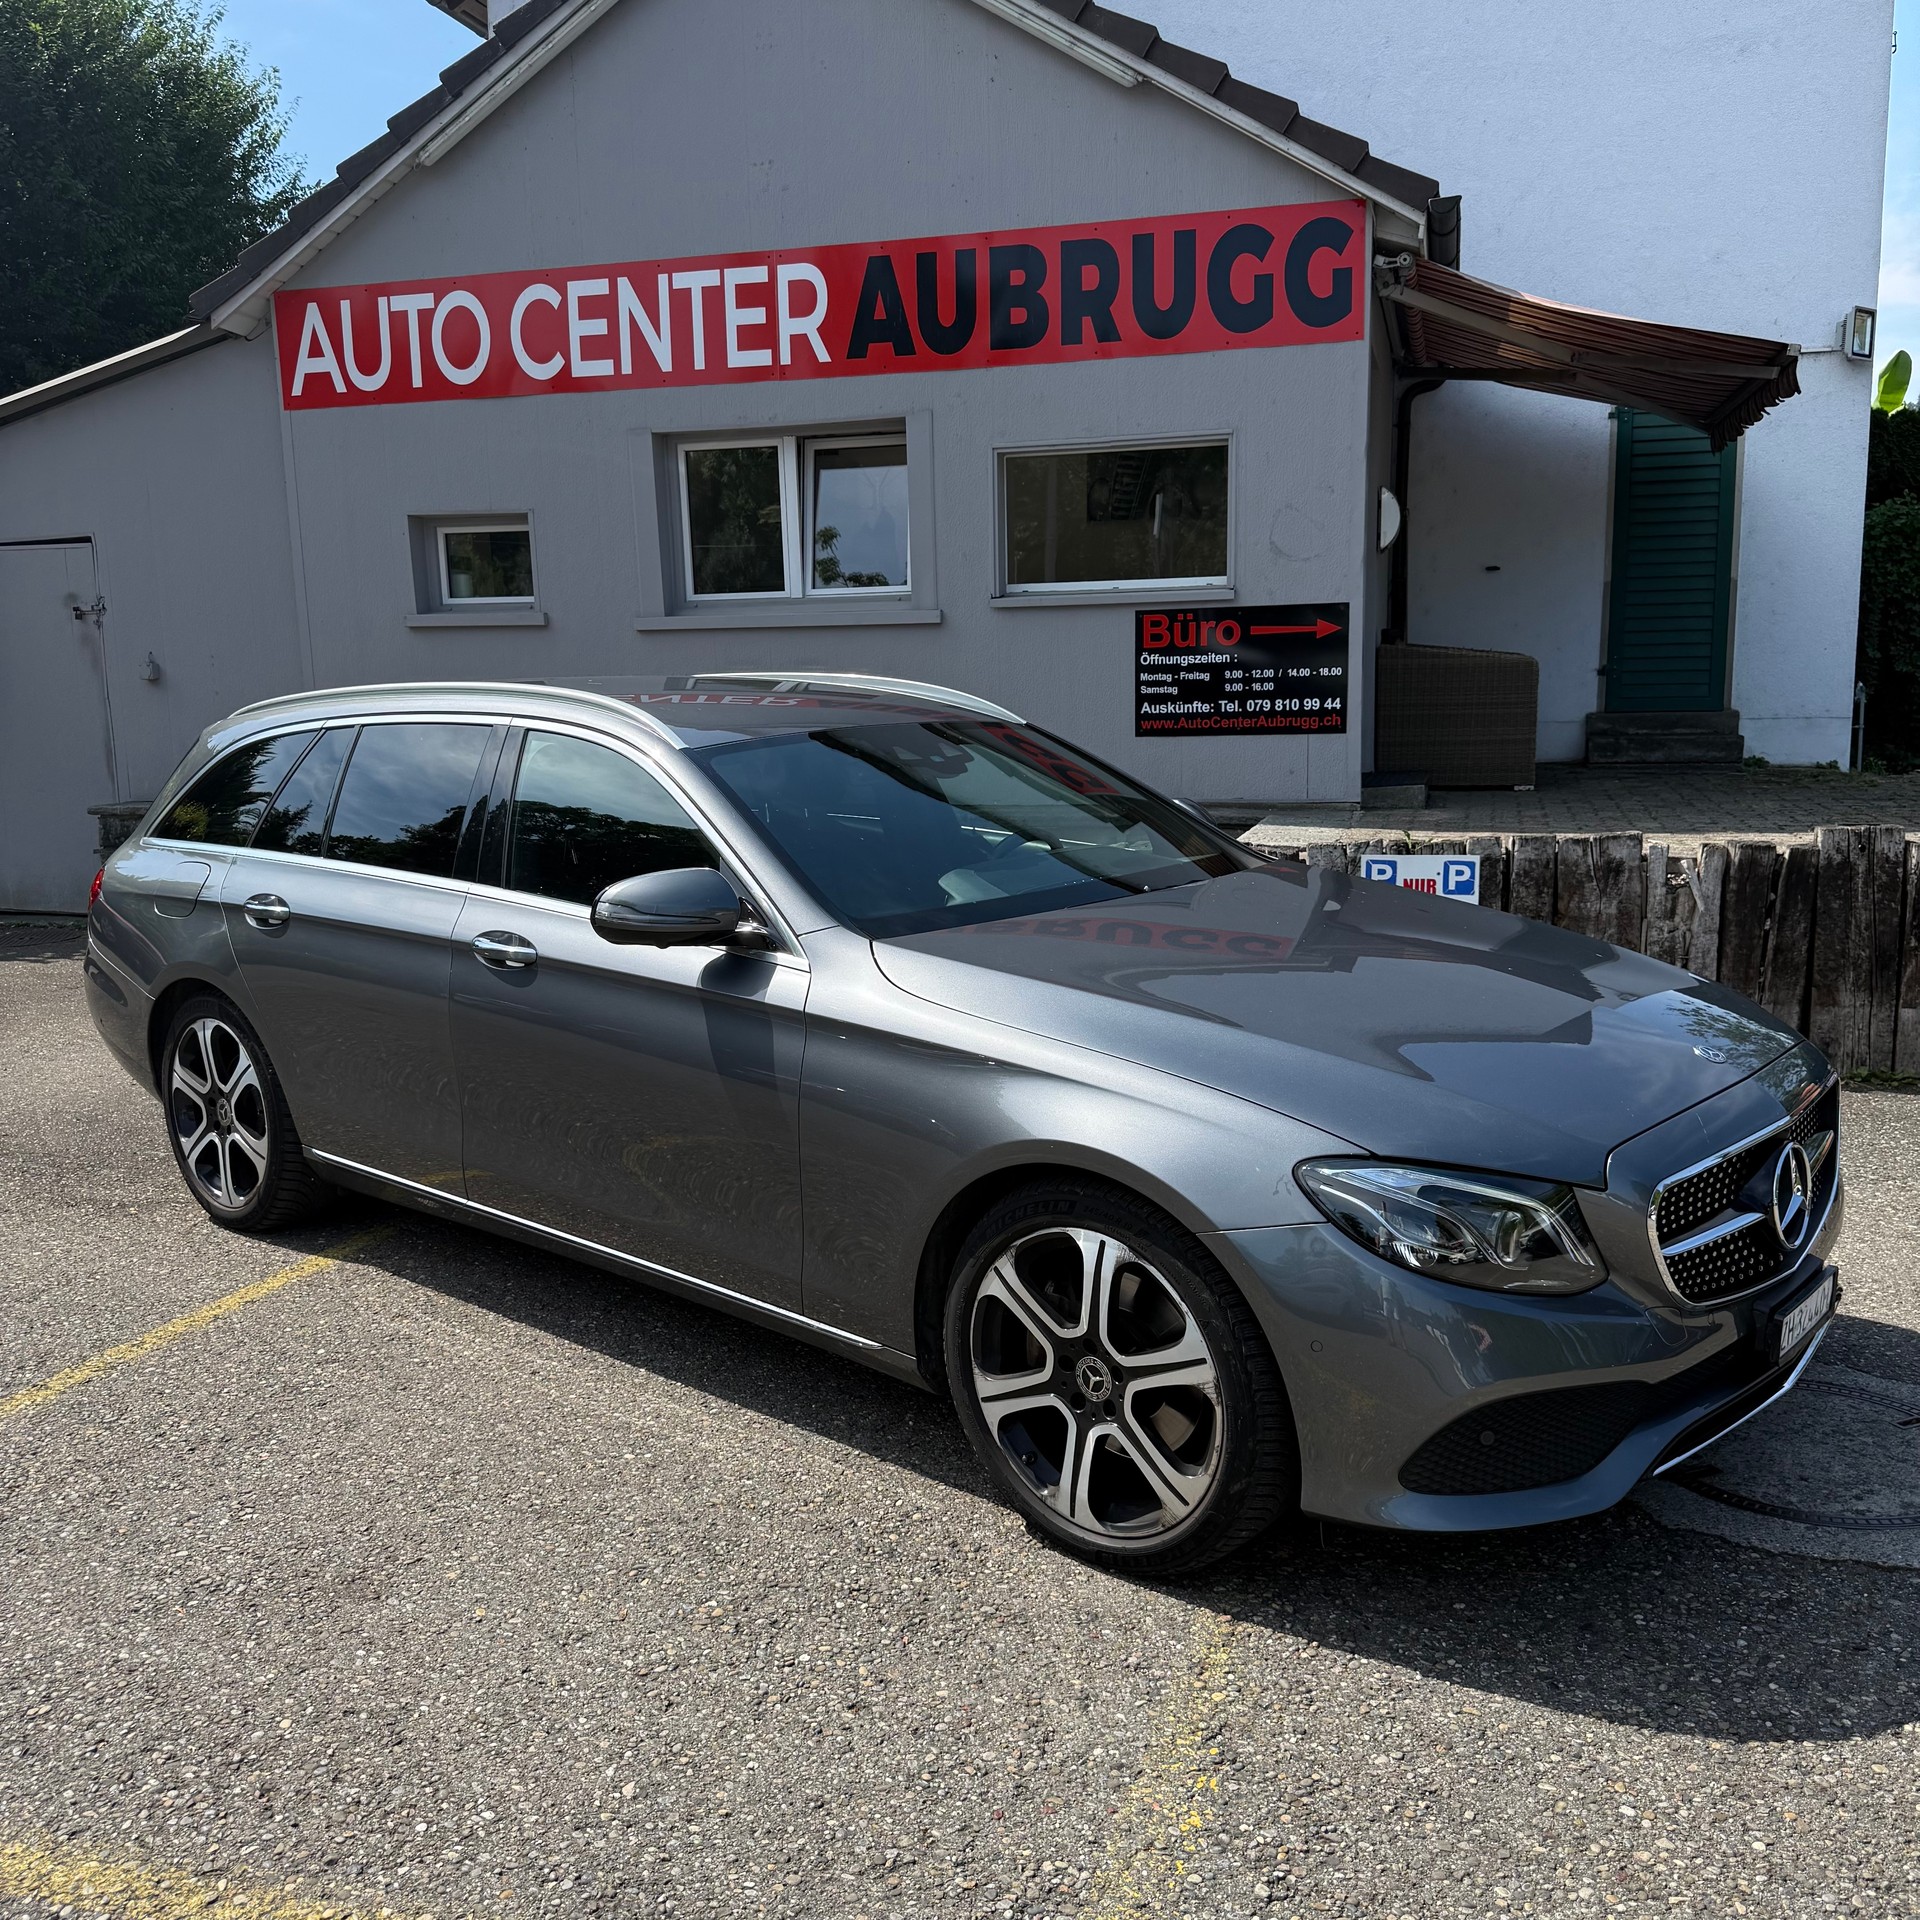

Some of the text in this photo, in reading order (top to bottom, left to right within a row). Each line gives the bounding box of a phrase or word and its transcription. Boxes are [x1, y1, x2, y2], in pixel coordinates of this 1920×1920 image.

[291, 217, 1354, 396] AUTO CENTER AUBRUGG
[1143, 613, 1241, 648] Büro
[1140, 652, 1230, 666] Öffnungszeiten
[1140, 673, 1172, 682] Montag
[1180, 671, 1210, 681] Freitag
[1225, 670, 1243, 678] 9.00
[1251, 669, 1274, 678] 12.00
[1287, 668, 1310, 677] 14.00
[1319, 667, 1342, 676] 18.00
[1140, 686, 1178, 695] Samstag
[1225, 683, 1243, 691] 9.00
[1251, 682, 1274, 691] 16.00
[1140, 697, 1341, 714] Auskünfte: Tel. 079 810 99 44
[1141, 714, 1341, 729] www.AutoCenterAubrugg.ch
[1448, 864, 1471, 890] P
